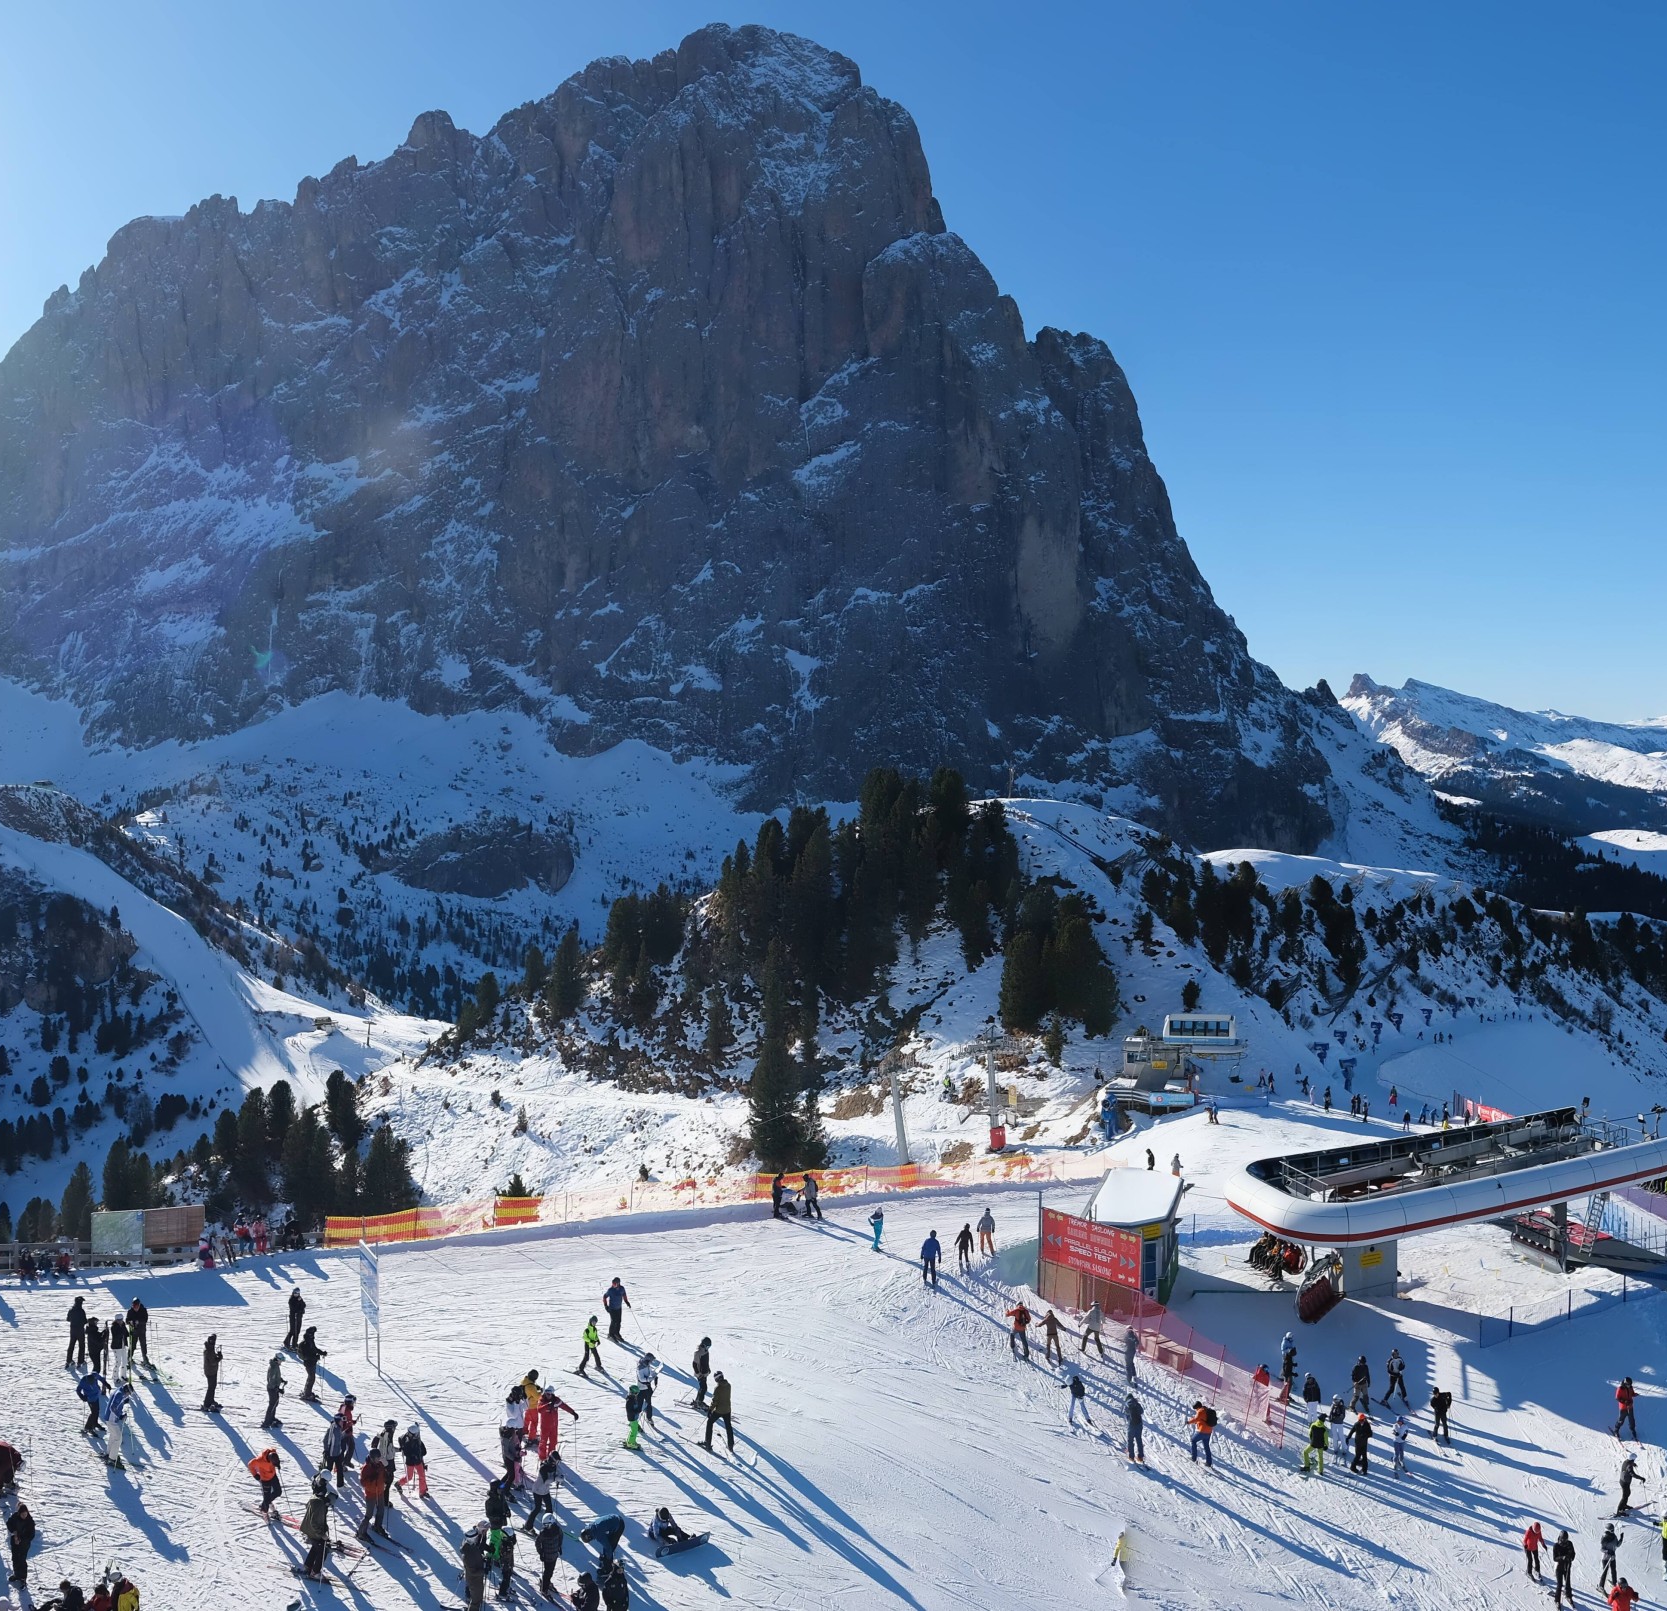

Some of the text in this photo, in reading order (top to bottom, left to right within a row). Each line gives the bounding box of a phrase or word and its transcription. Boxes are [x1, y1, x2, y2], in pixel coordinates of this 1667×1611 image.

[1068, 1218, 1115, 1237] TREMOR SASLONG
[1064, 1237, 1117, 1258] PARALLEL SLALOM
[1069, 1246, 1111, 1263] SPEED TEST
